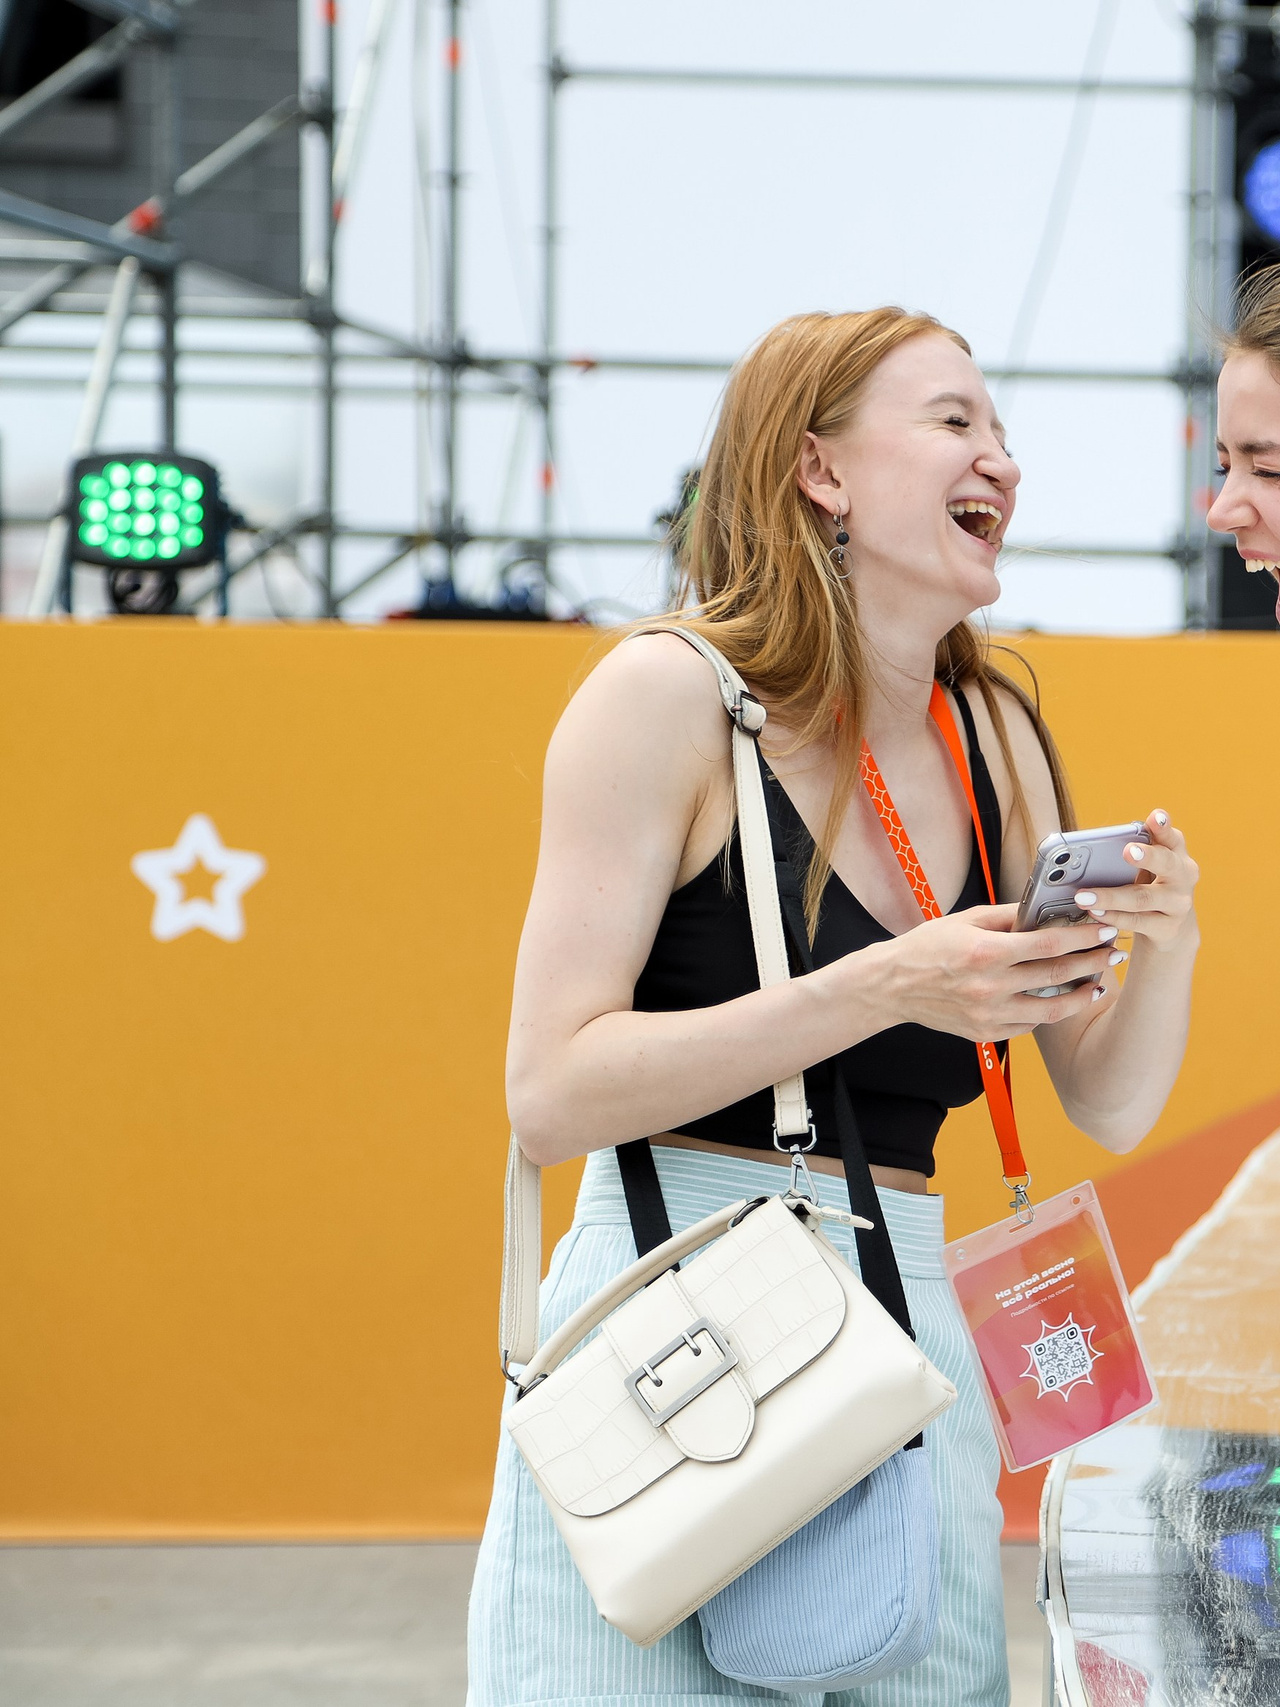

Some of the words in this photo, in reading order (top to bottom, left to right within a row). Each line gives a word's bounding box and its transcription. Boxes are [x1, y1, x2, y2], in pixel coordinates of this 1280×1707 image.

[995, 1288, 1012, 1300] На
[1013, 1273, 1040, 1292] этой
[1041, 1257, 1075, 1278] весне
[1001, 1293, 1023, 1308] всё
[1024, 1267, 1075, 1299] реально!
